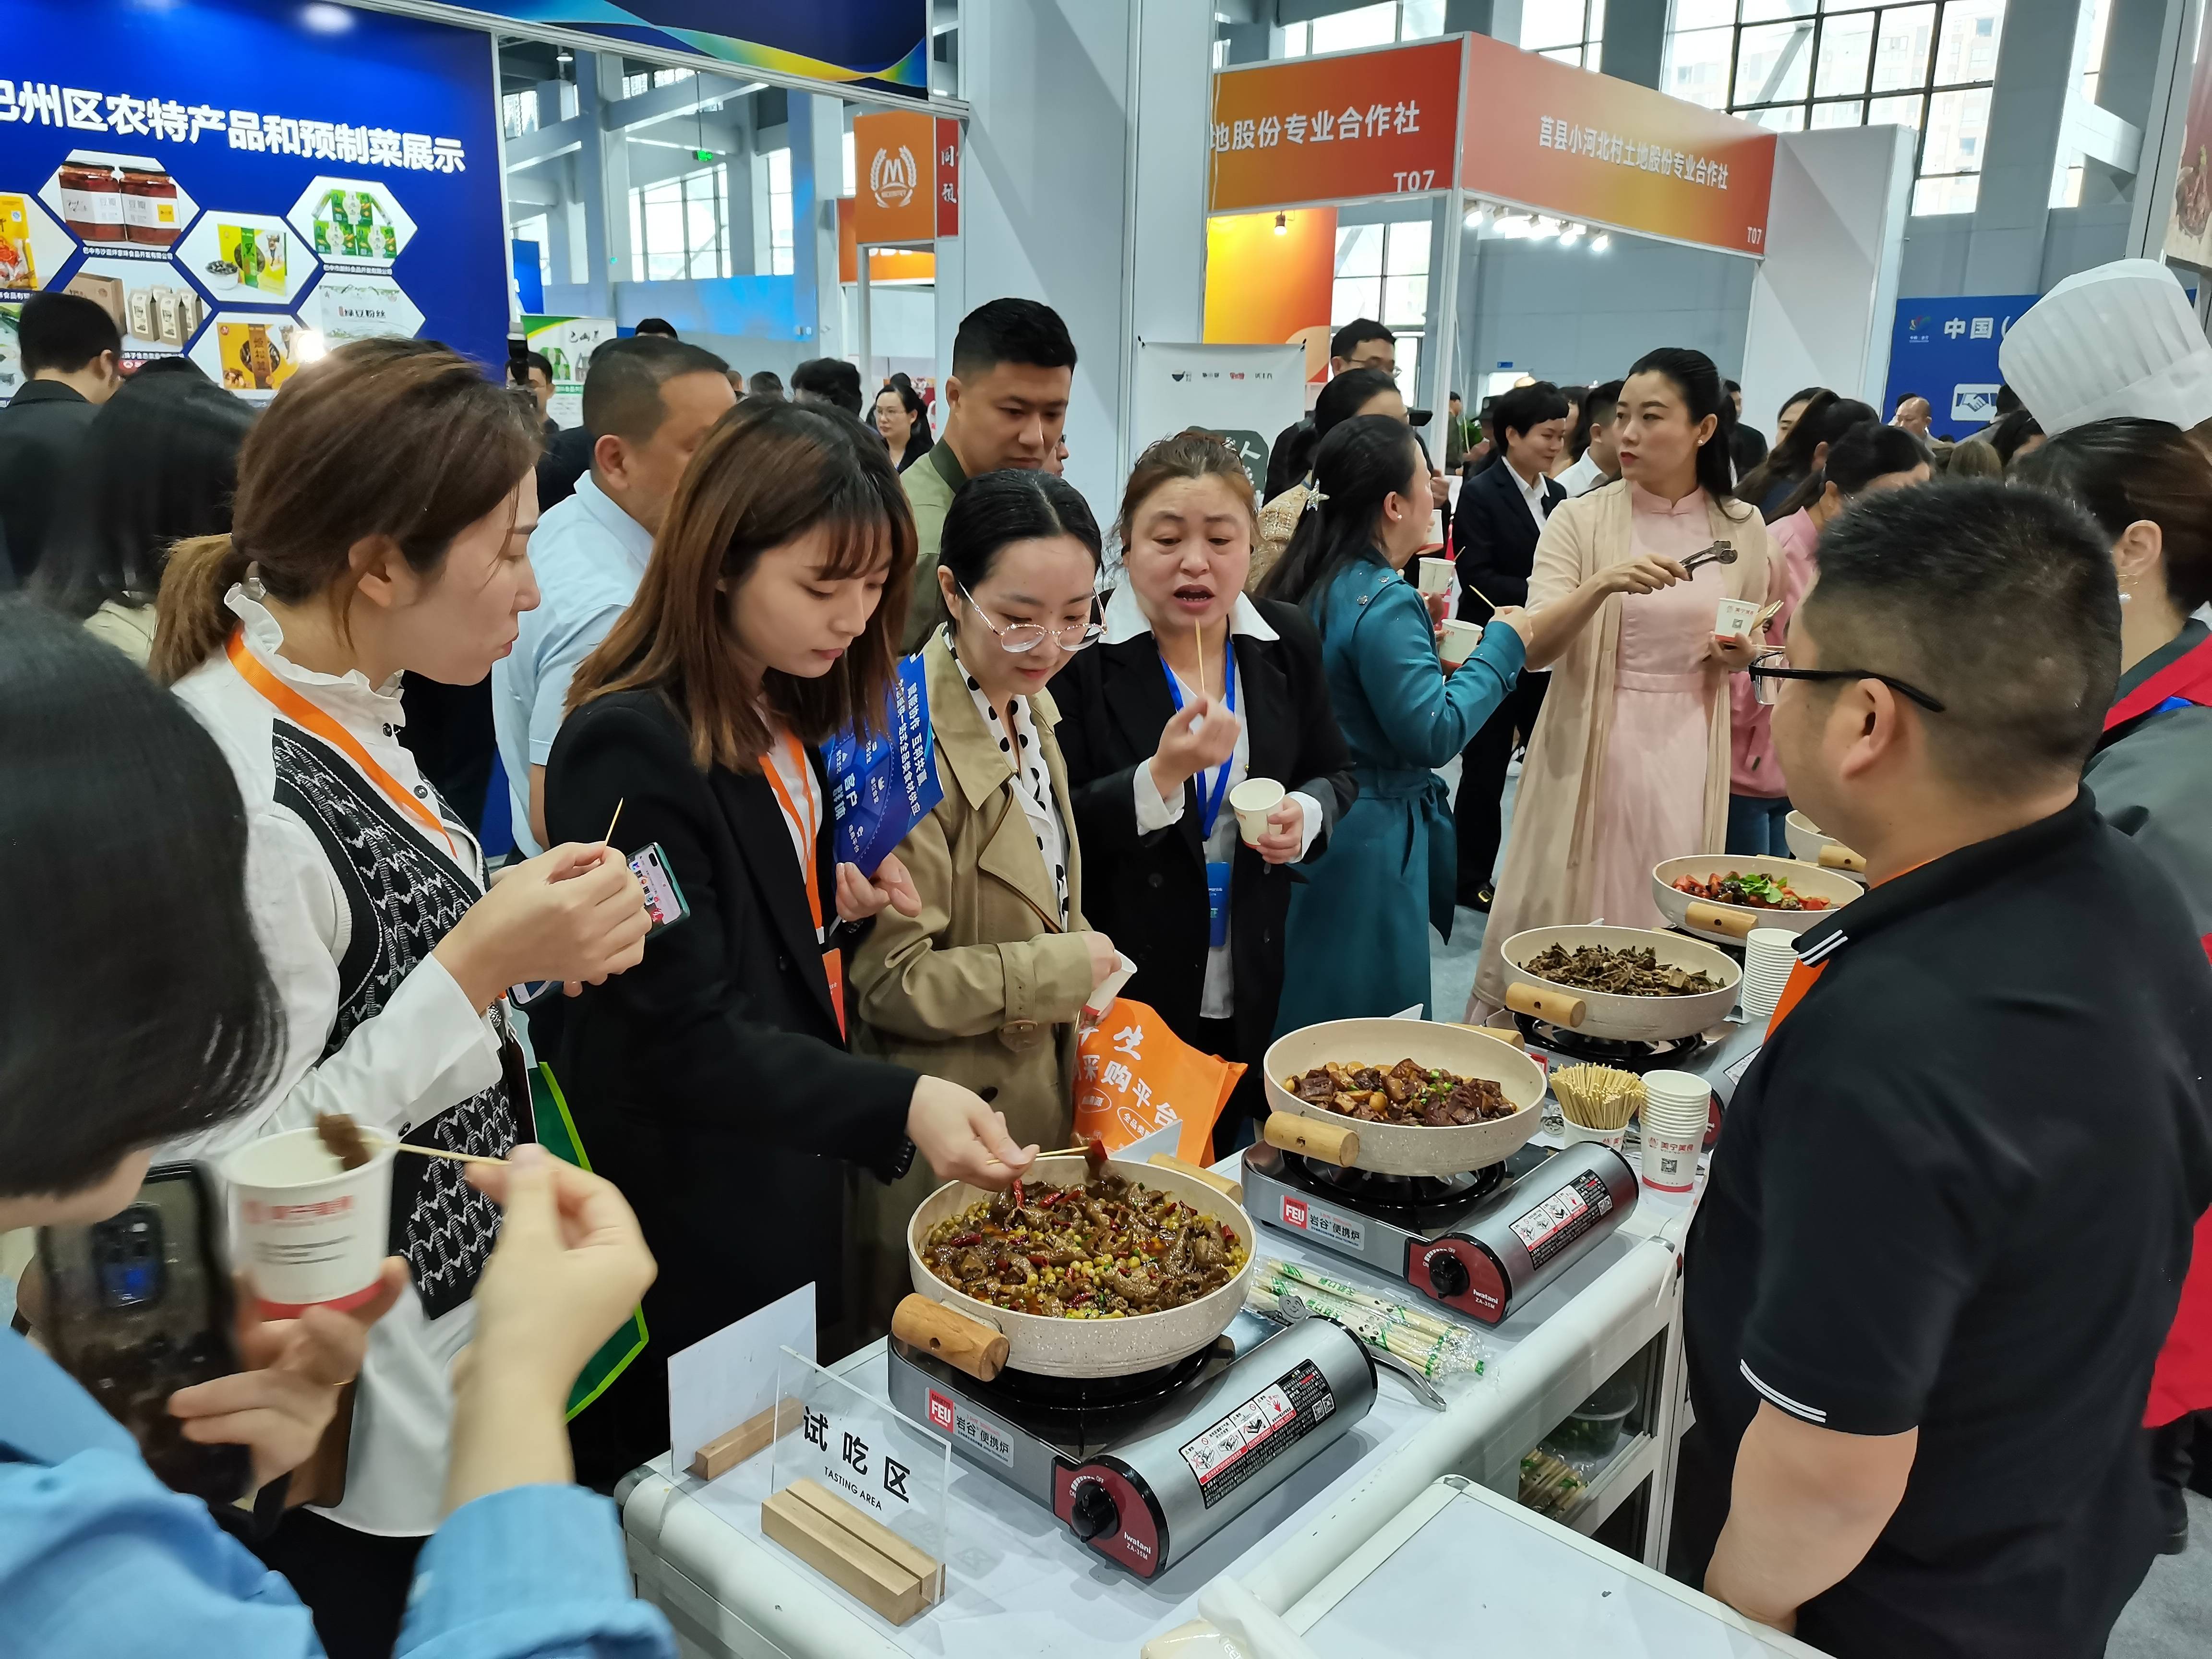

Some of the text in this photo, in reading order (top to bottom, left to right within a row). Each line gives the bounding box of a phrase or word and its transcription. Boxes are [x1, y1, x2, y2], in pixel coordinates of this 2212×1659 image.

[1210, 100, 1420, 152] 地股份专业合作社
[1539, 115, 1728, 190] 莒县小河北村土地股份专业合作社
[1394, 170, 1435, 192] T07
[1747, 227, 1762, 245] T07
[844, 772, 857, 807] 客户
[1286, 1206, 1305, 1222] FEU
[1310, 1214, 1328, 1230] 岩谷
[1333, 1223, 1360, 1240] 便携炉
[1473, 1289, 1498, 1304] Iwatani
[931, 1400, 951, 1424] FEU
[956, 1416, 976, 1437] 岩谷
[980, 1430, 1009, 1454] 便携炉
[804, 1406, 910, 1503] 试吃区
[824, 1466, 882, 1511] TASTING AREA
[1124, 1531, 1151, 1554] Iwatani
[1127, 1543, 1148, 1560] ZA-35M
